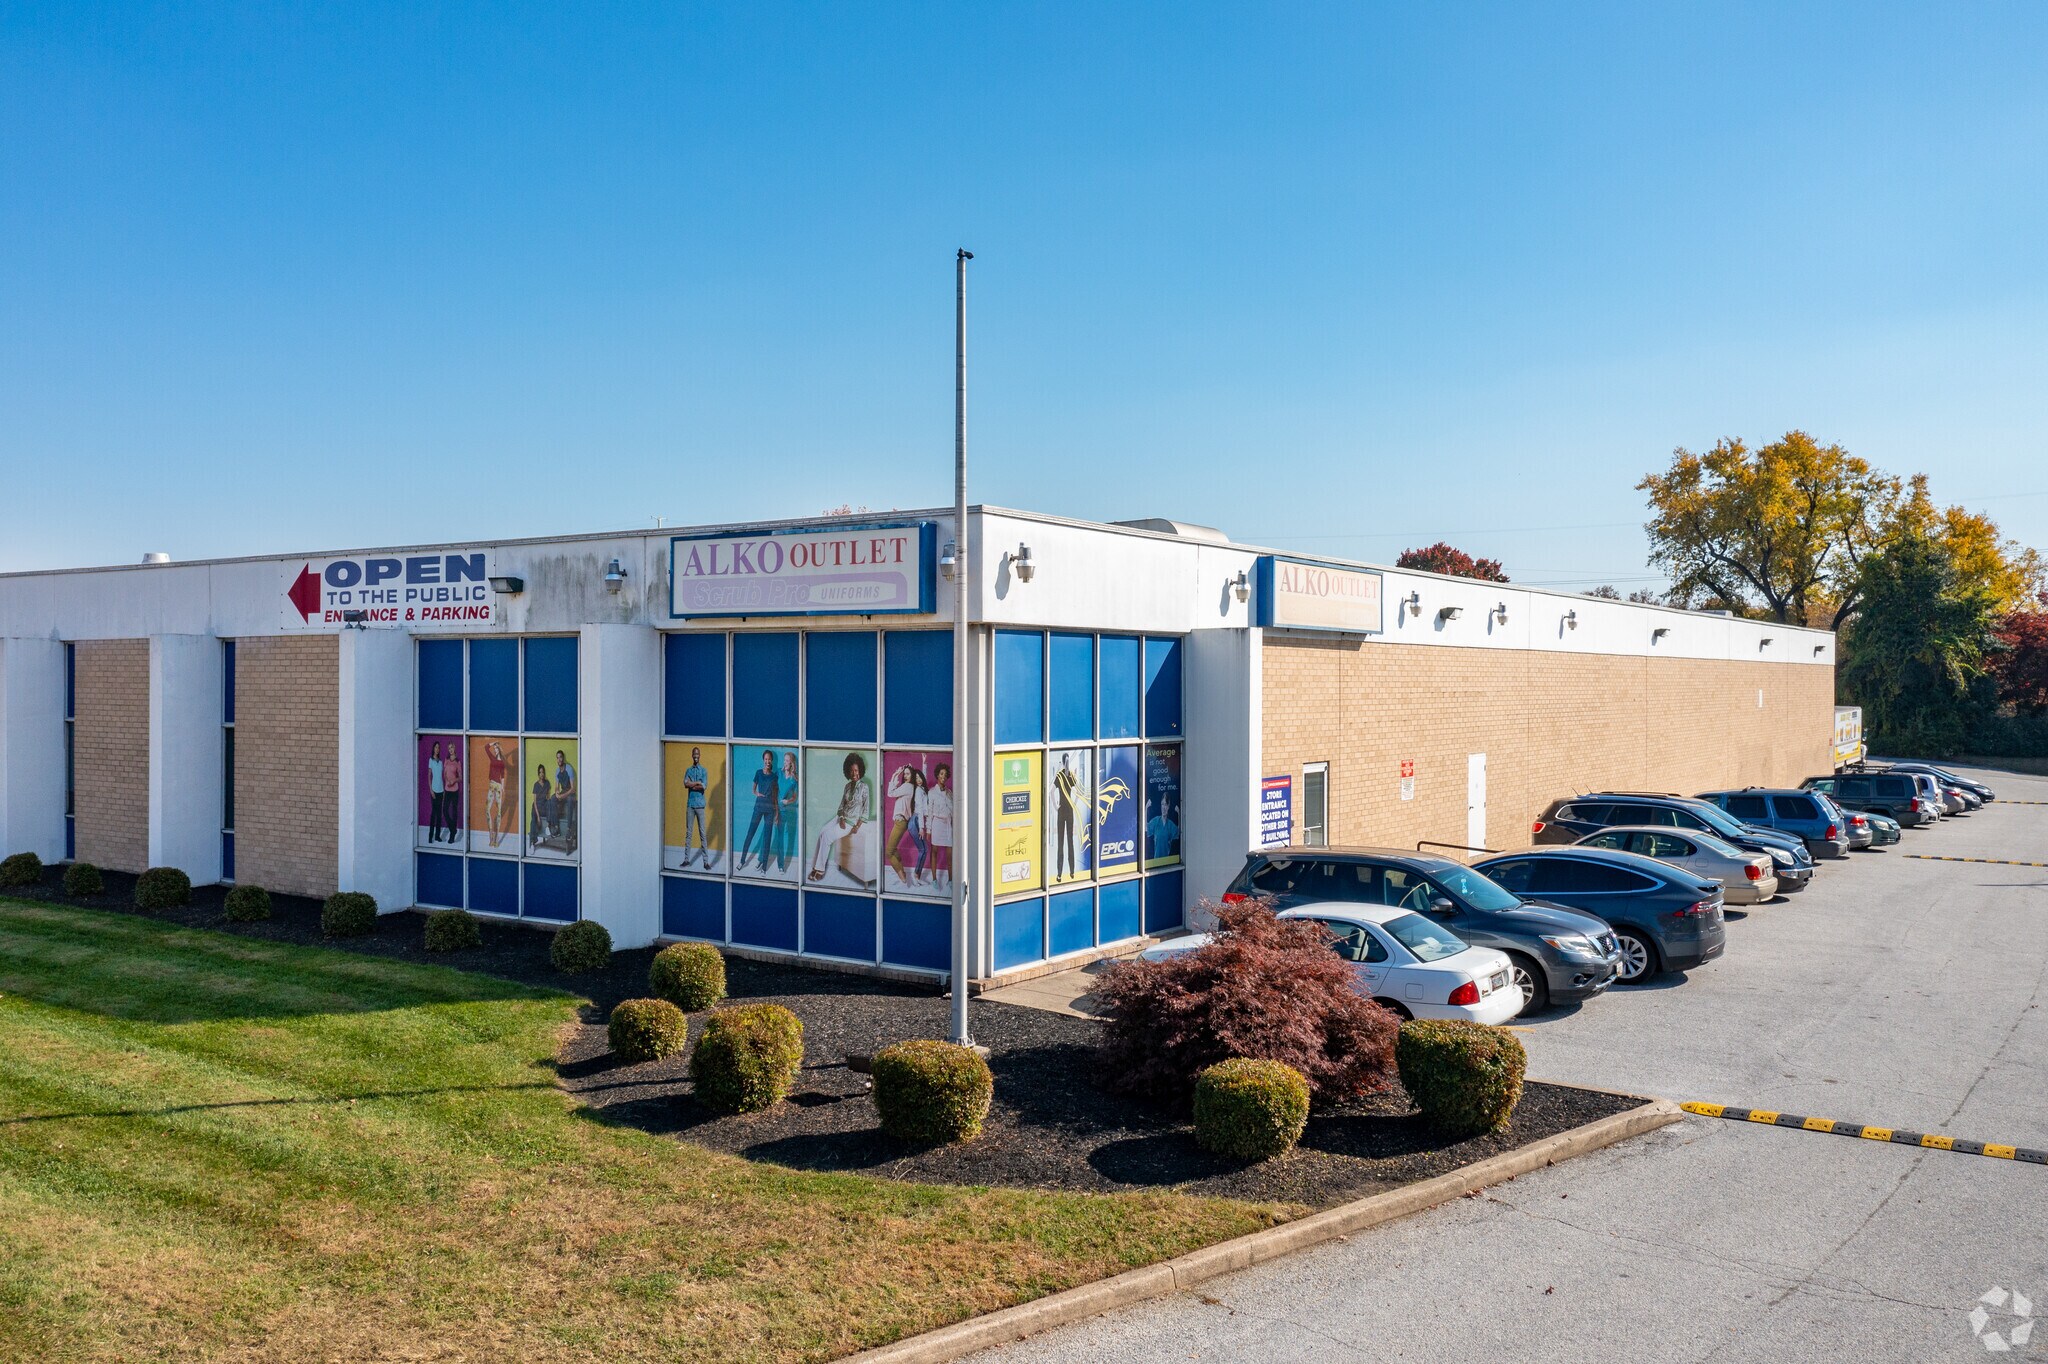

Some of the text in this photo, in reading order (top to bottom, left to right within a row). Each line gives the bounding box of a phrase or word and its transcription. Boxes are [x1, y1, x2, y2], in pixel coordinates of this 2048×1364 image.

[682, 537, 908, 577] ALKO OUTLET
[324, 553, 486, 587] OPEN
[1280, 565, 1378, 599] ALKO OUTLET
[326, 586, 486, 605] TO THE PUBLIC
[693, 578, 880, 607] Scrub Pro UNIFORMS
[324, 605, 490, 623] ENNCE & PARKING
[1146, 748, 1176, 758] Average
[1153, 767, 1169, 775] good
[1149, 775, 1171, 784] enough
[1266, 790, 1282, 800] STORE
[1262, 800, 1287, 811] ENTRANCE
[1262, 810, 1289, 821] OCATED ON
[1277, 820, 1288, 830] SIDE
